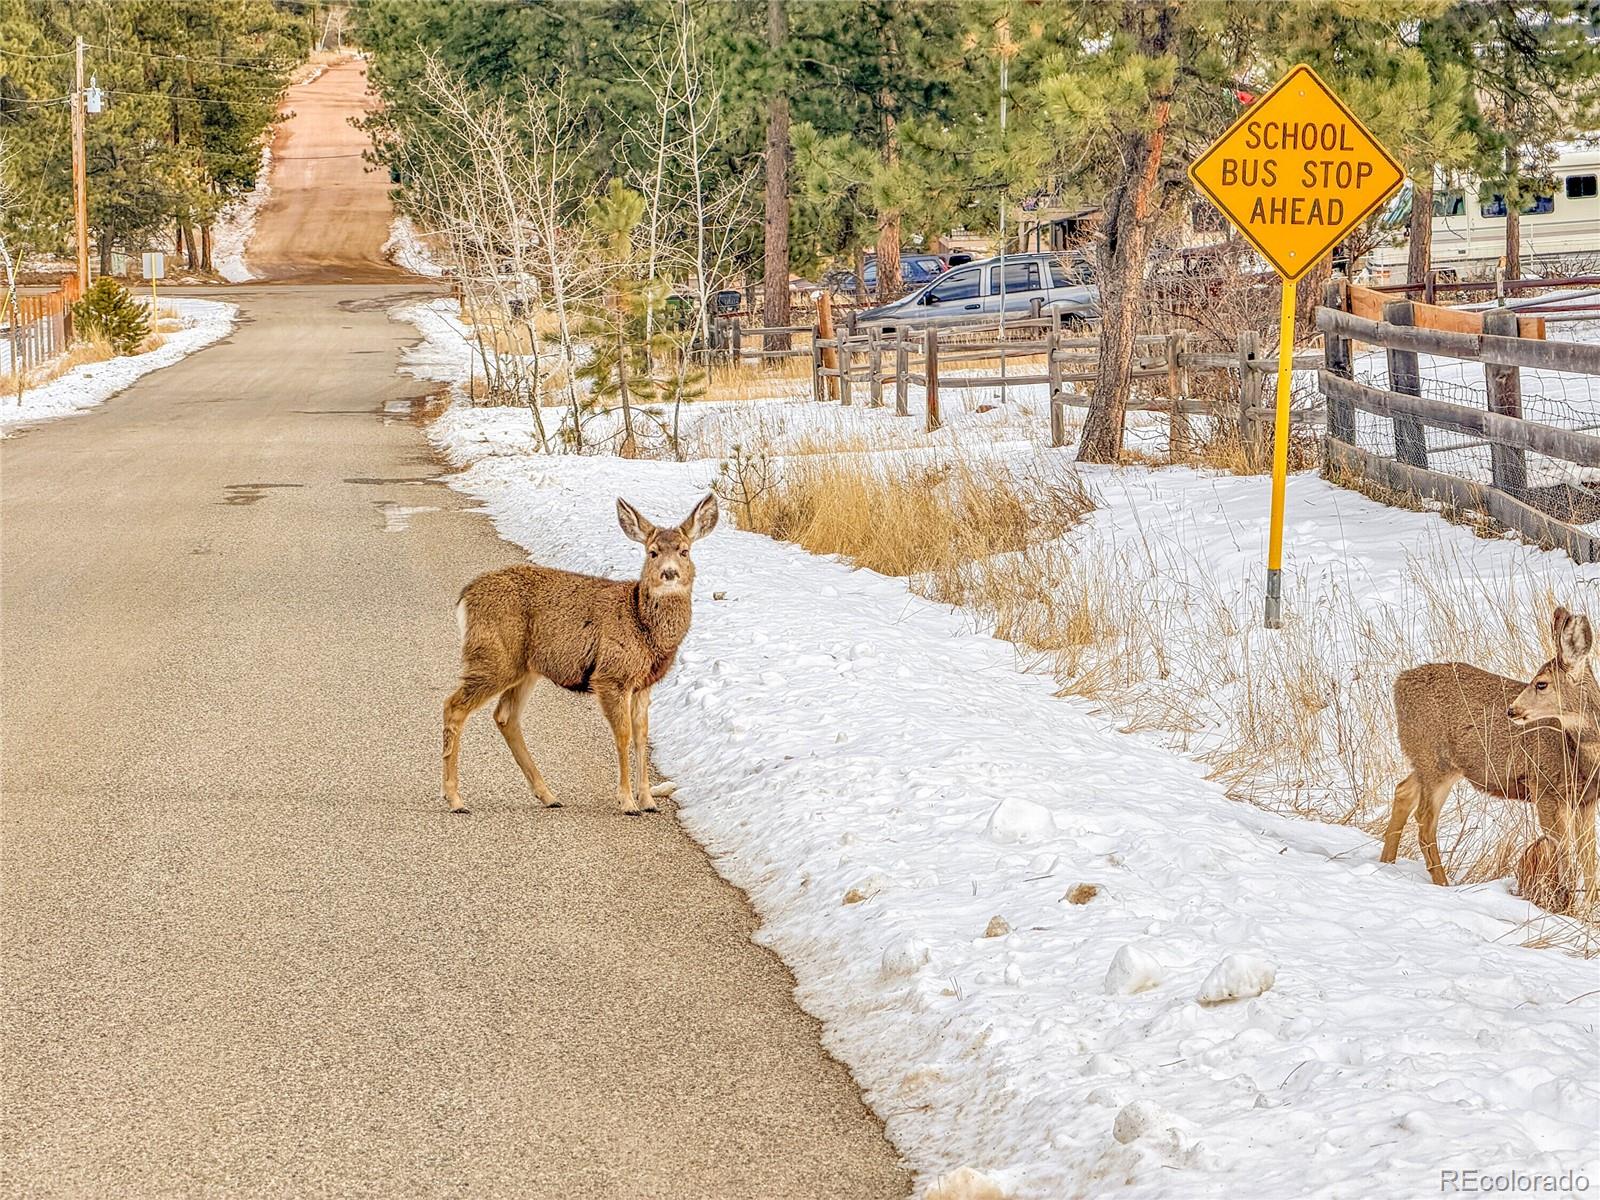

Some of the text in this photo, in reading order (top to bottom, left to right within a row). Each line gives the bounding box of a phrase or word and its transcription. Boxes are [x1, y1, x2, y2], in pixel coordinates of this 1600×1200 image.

[1245, 121, 1354, 151] SCHOOL
[1221, 158, 1373, 189] BUS STOP
[1249, 197, 1344, 226] AHEAD
